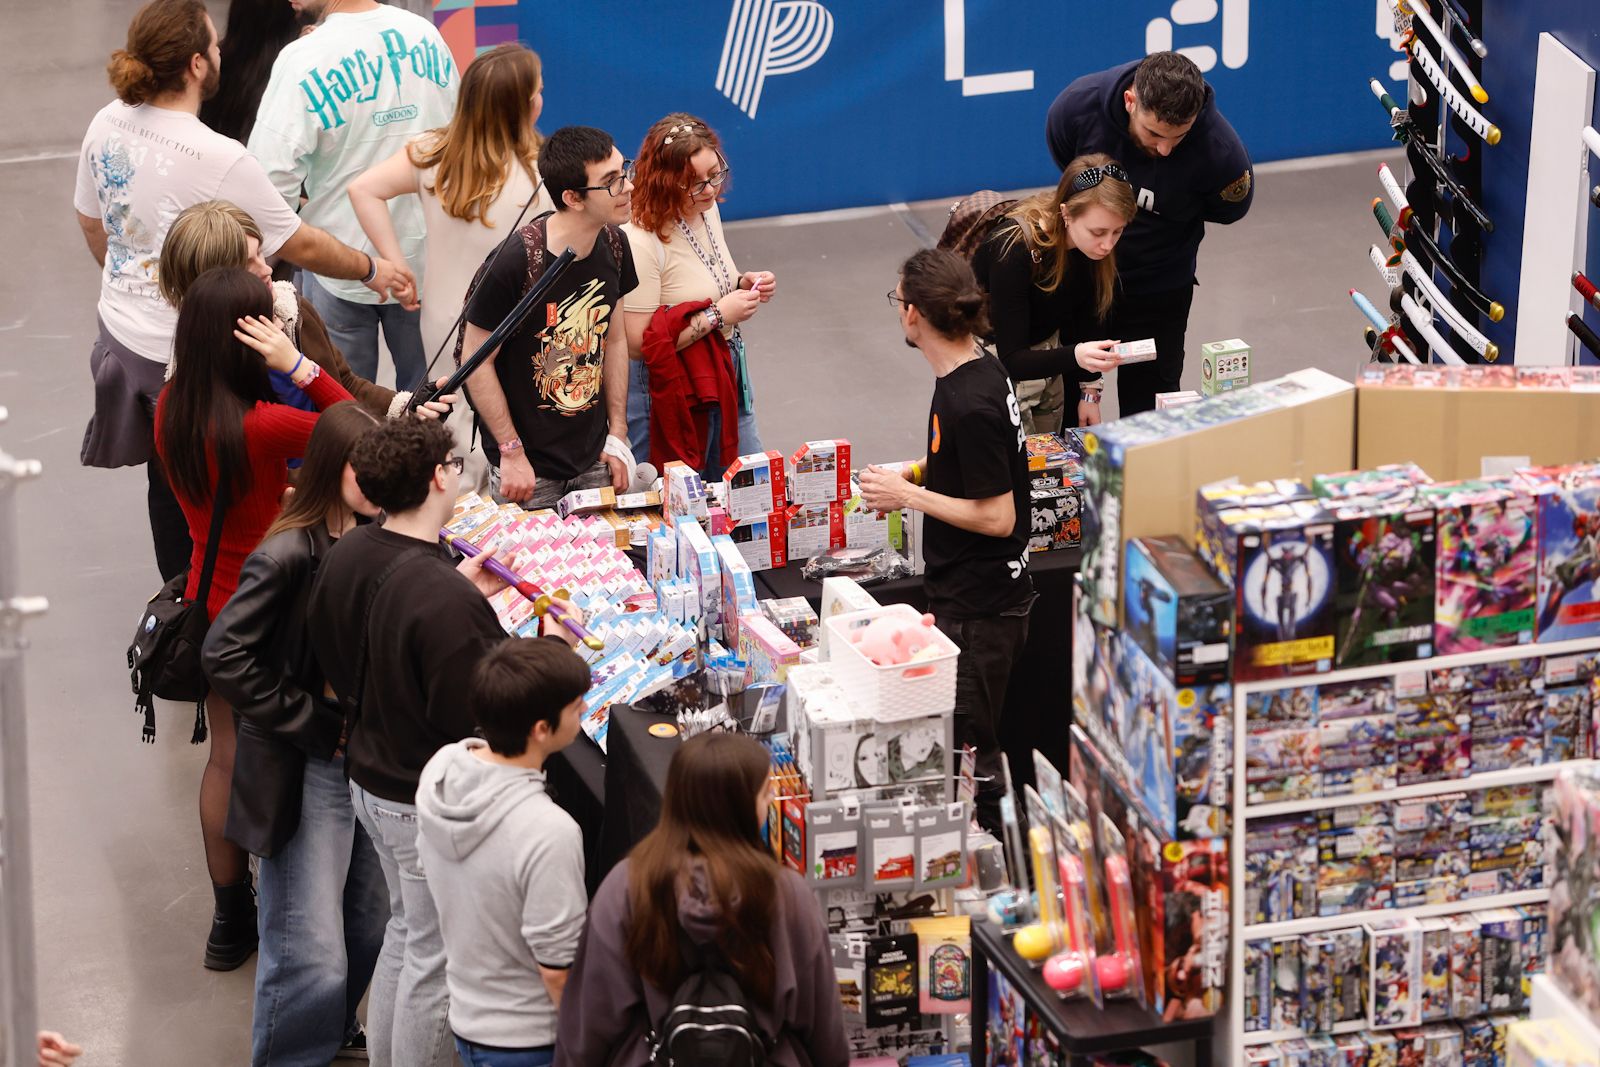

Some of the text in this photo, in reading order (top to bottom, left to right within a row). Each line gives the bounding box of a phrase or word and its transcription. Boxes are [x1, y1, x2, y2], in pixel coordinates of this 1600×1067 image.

[298, 28, 451, 130] Harry Pott
[378, 108, 413, 123] LONDON
[139, 128, 204, 160] REFLECTION
